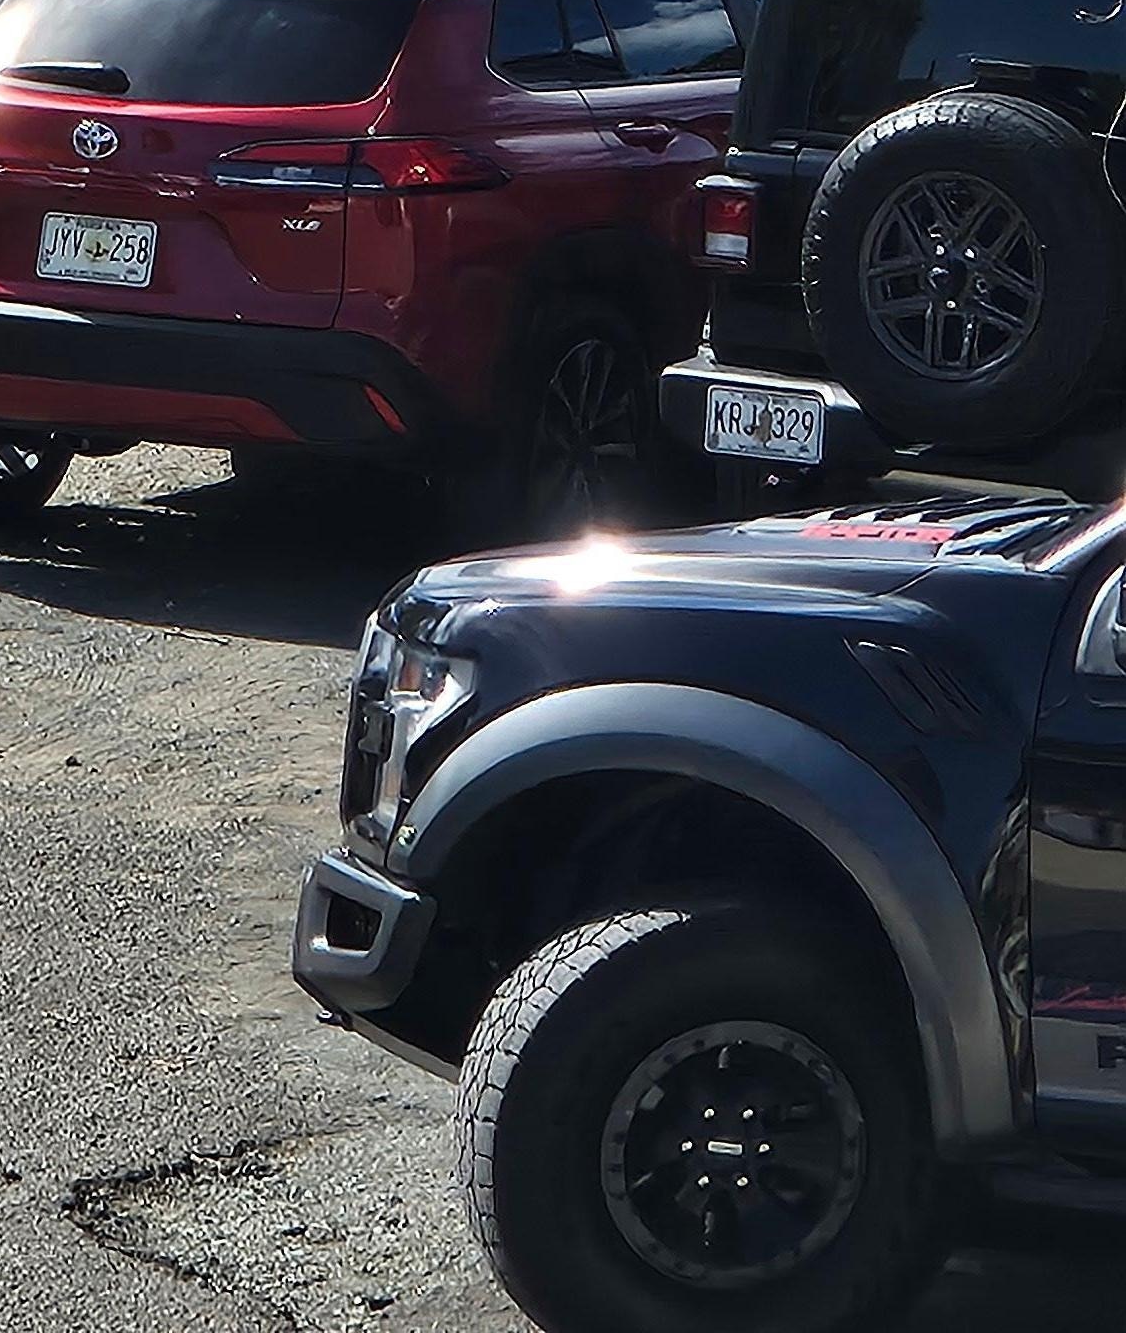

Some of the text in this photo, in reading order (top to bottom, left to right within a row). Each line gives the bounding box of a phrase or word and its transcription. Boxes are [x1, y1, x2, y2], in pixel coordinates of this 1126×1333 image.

[49, 227, 149, 265] JYV 258
[771, 406, 815, 443] 329
